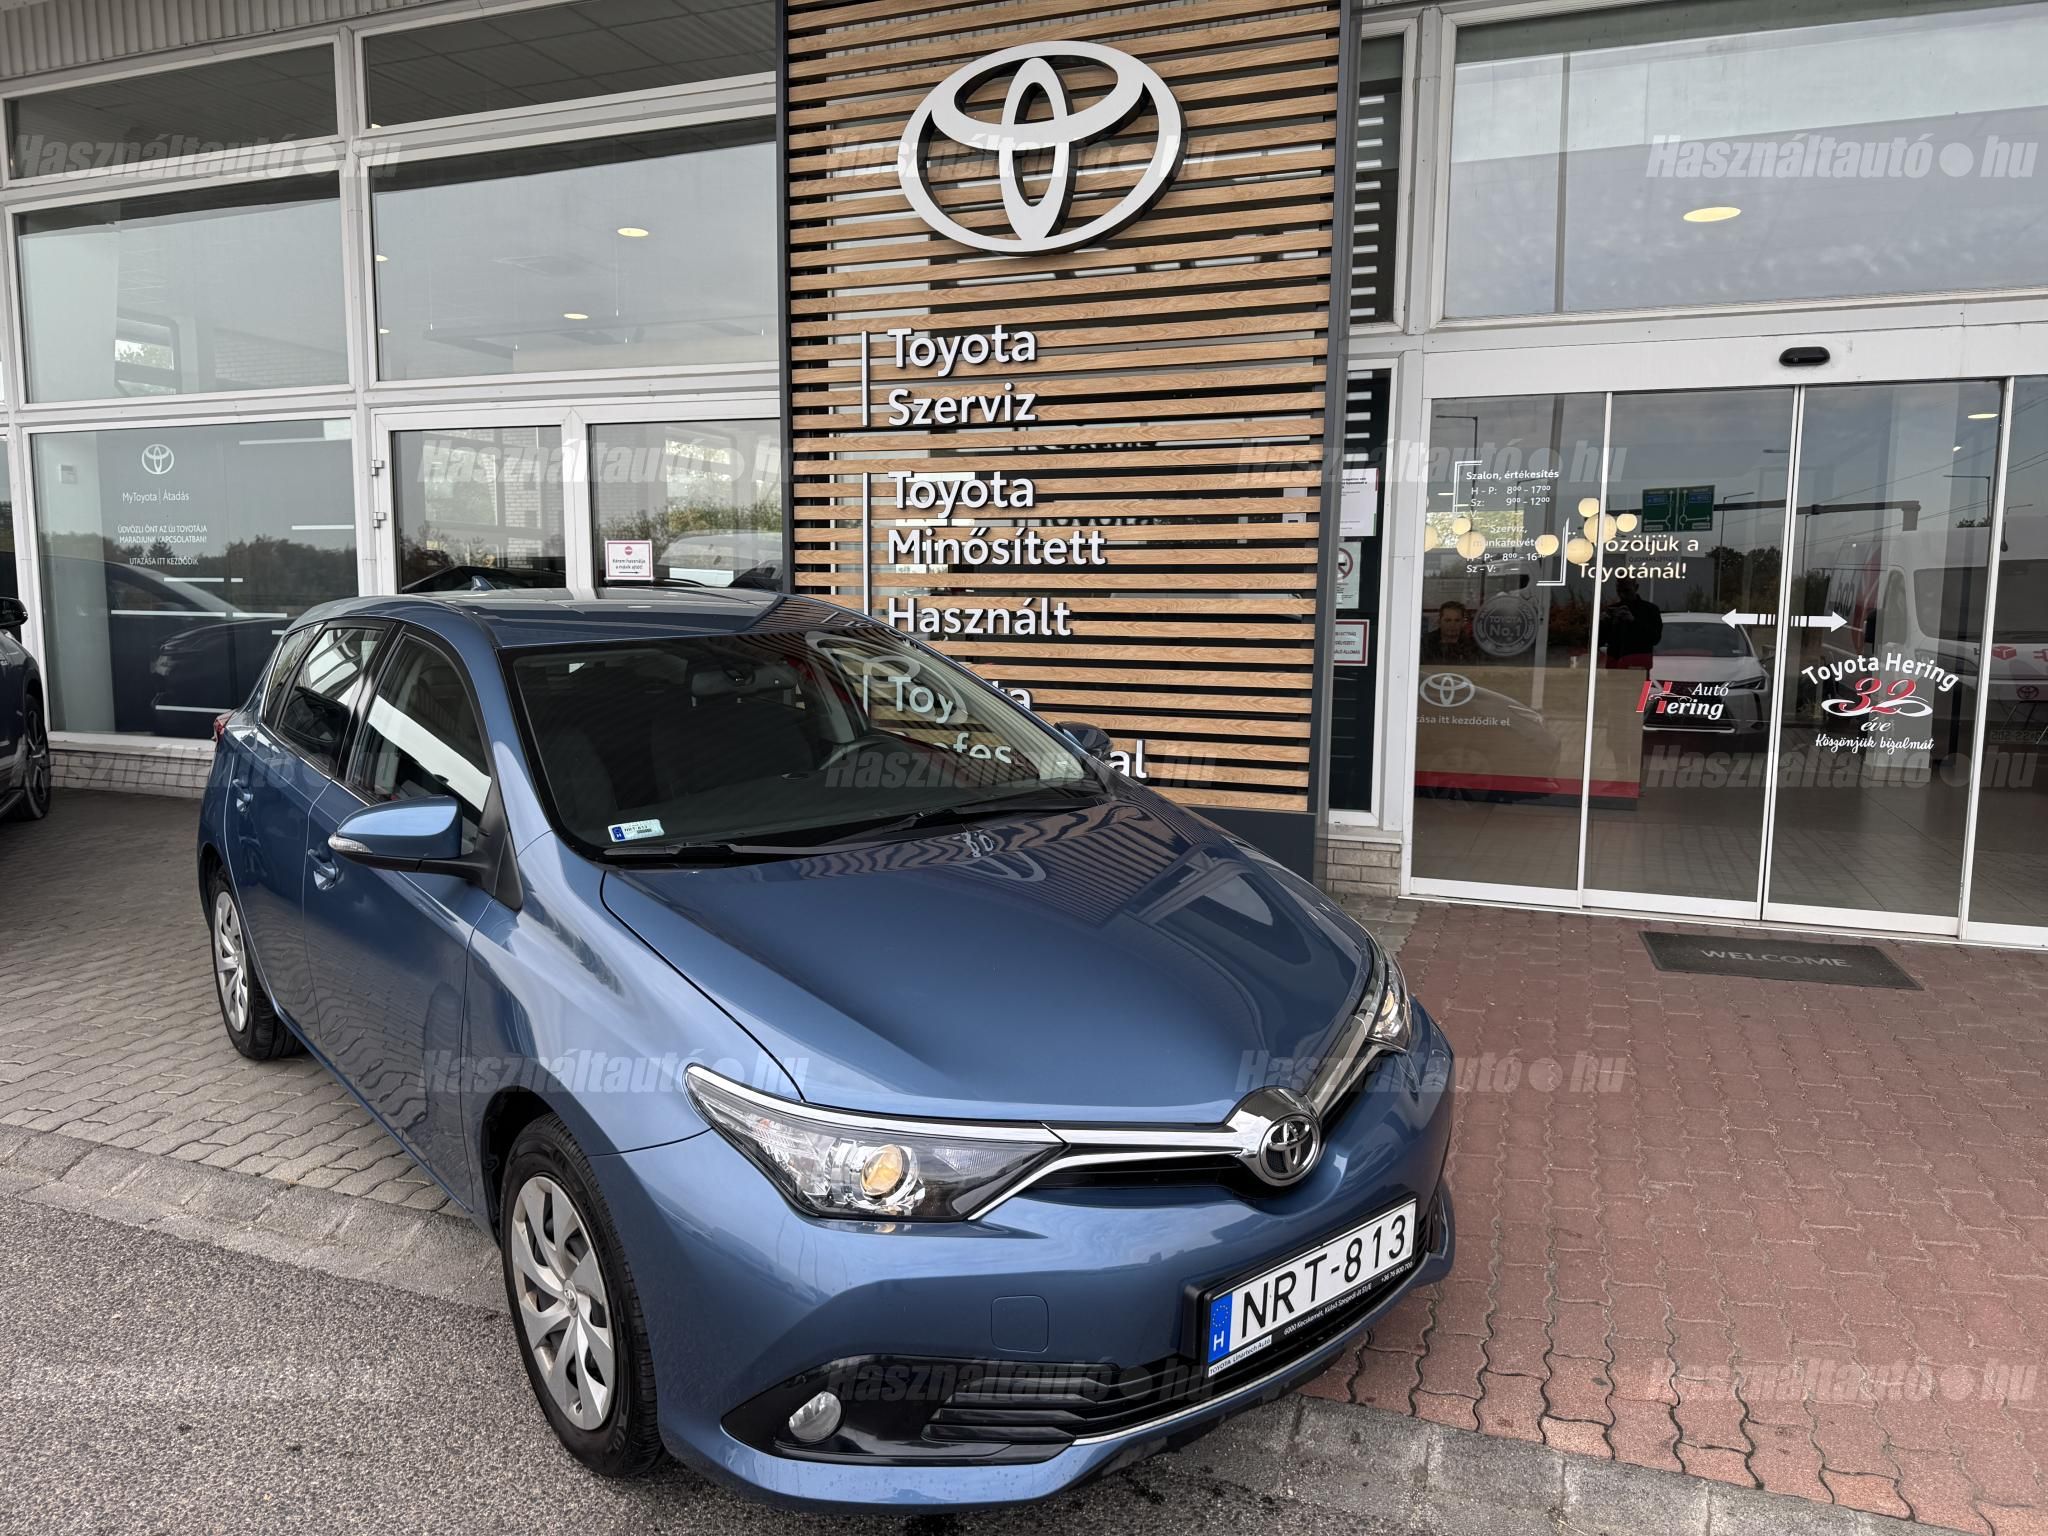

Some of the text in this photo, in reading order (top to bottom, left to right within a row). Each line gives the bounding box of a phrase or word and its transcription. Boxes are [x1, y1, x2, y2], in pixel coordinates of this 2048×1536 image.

[887, 325, 1038, 377] Toyota
[887, 382, 1039, 427] Szerviz
[1466, 469, 1559, 481] Szalon, értékesítés
[122, 489, 189, 504] MyToyota Átadás
[887, 470, 1036, 519] Toyota
[1470, 499, 1485, 507] Sz:
[160, 525, 167, 533] AZ
[1490, 525, 1528, 533] Szerviz,
[888, 526, 1108, 566] Minősített
[1687, 539, 1699, 552] a
[1578, 562, 1687, 583] Toyotánál!
[887, 597, 1073, 636] Használt
[1489, 624, 1521, 637] No.1
[1801, 652, 1959, 692] Toyota Hering
[1691, 682, 1730, 696] Autó
[1838, 677, 1916, 714] 32
[1860, 716, 1892, 732] éve
[1815, 733, 1934, 754] Köszönjük bizalmát
[1702, 950, 1852, 967] WELCOME
[1241, 1214, 1406, 1339] NRT-813
[1213, 1331, 1225, 1352] H
